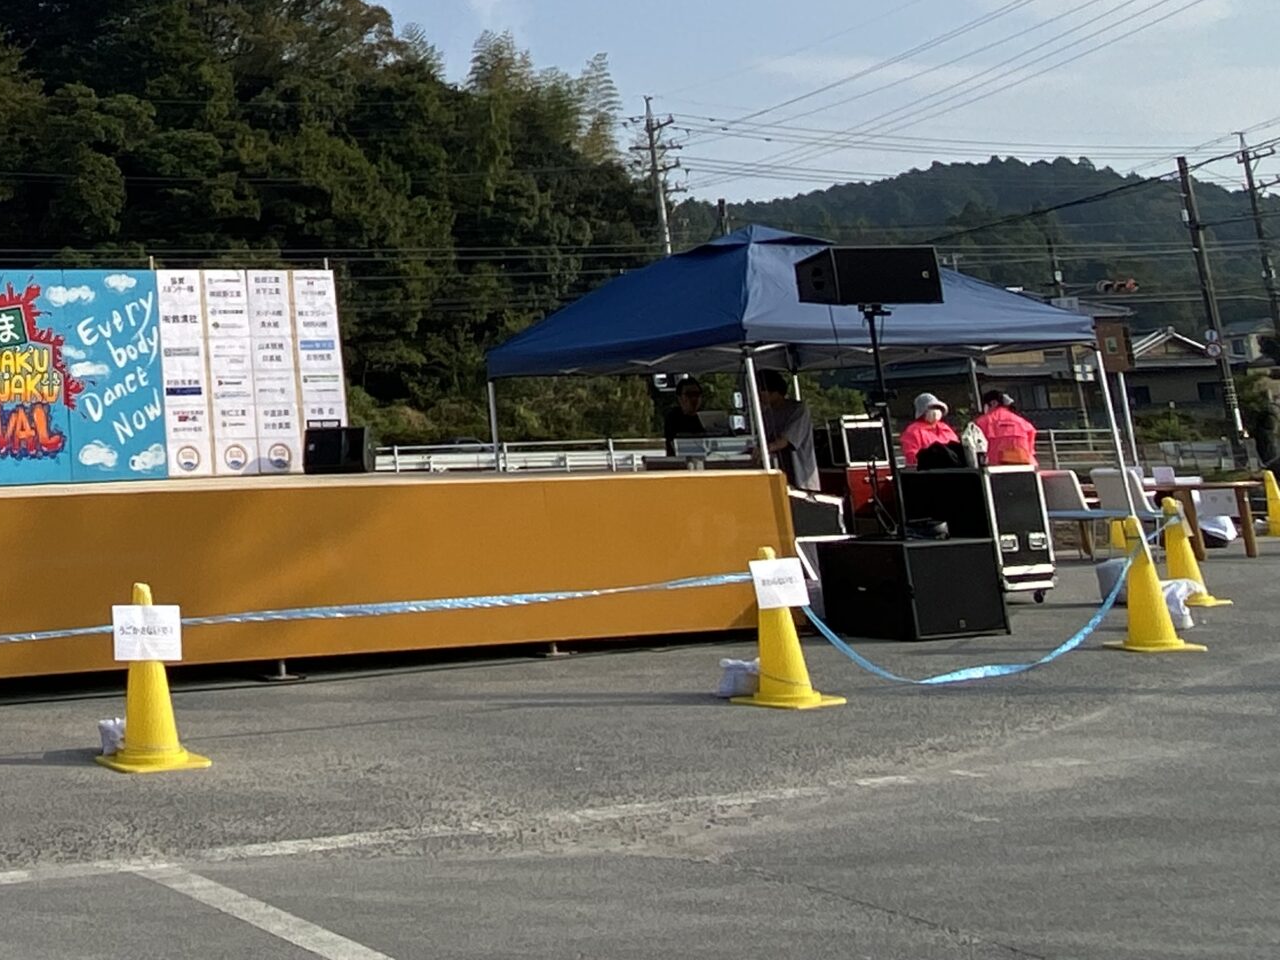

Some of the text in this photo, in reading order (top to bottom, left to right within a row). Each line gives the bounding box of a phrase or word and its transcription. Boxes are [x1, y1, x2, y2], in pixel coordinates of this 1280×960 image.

[76, 291, 154, 346] Every
[106, 326, 159, 369] body
[80, 366, 149, 423] Dance
